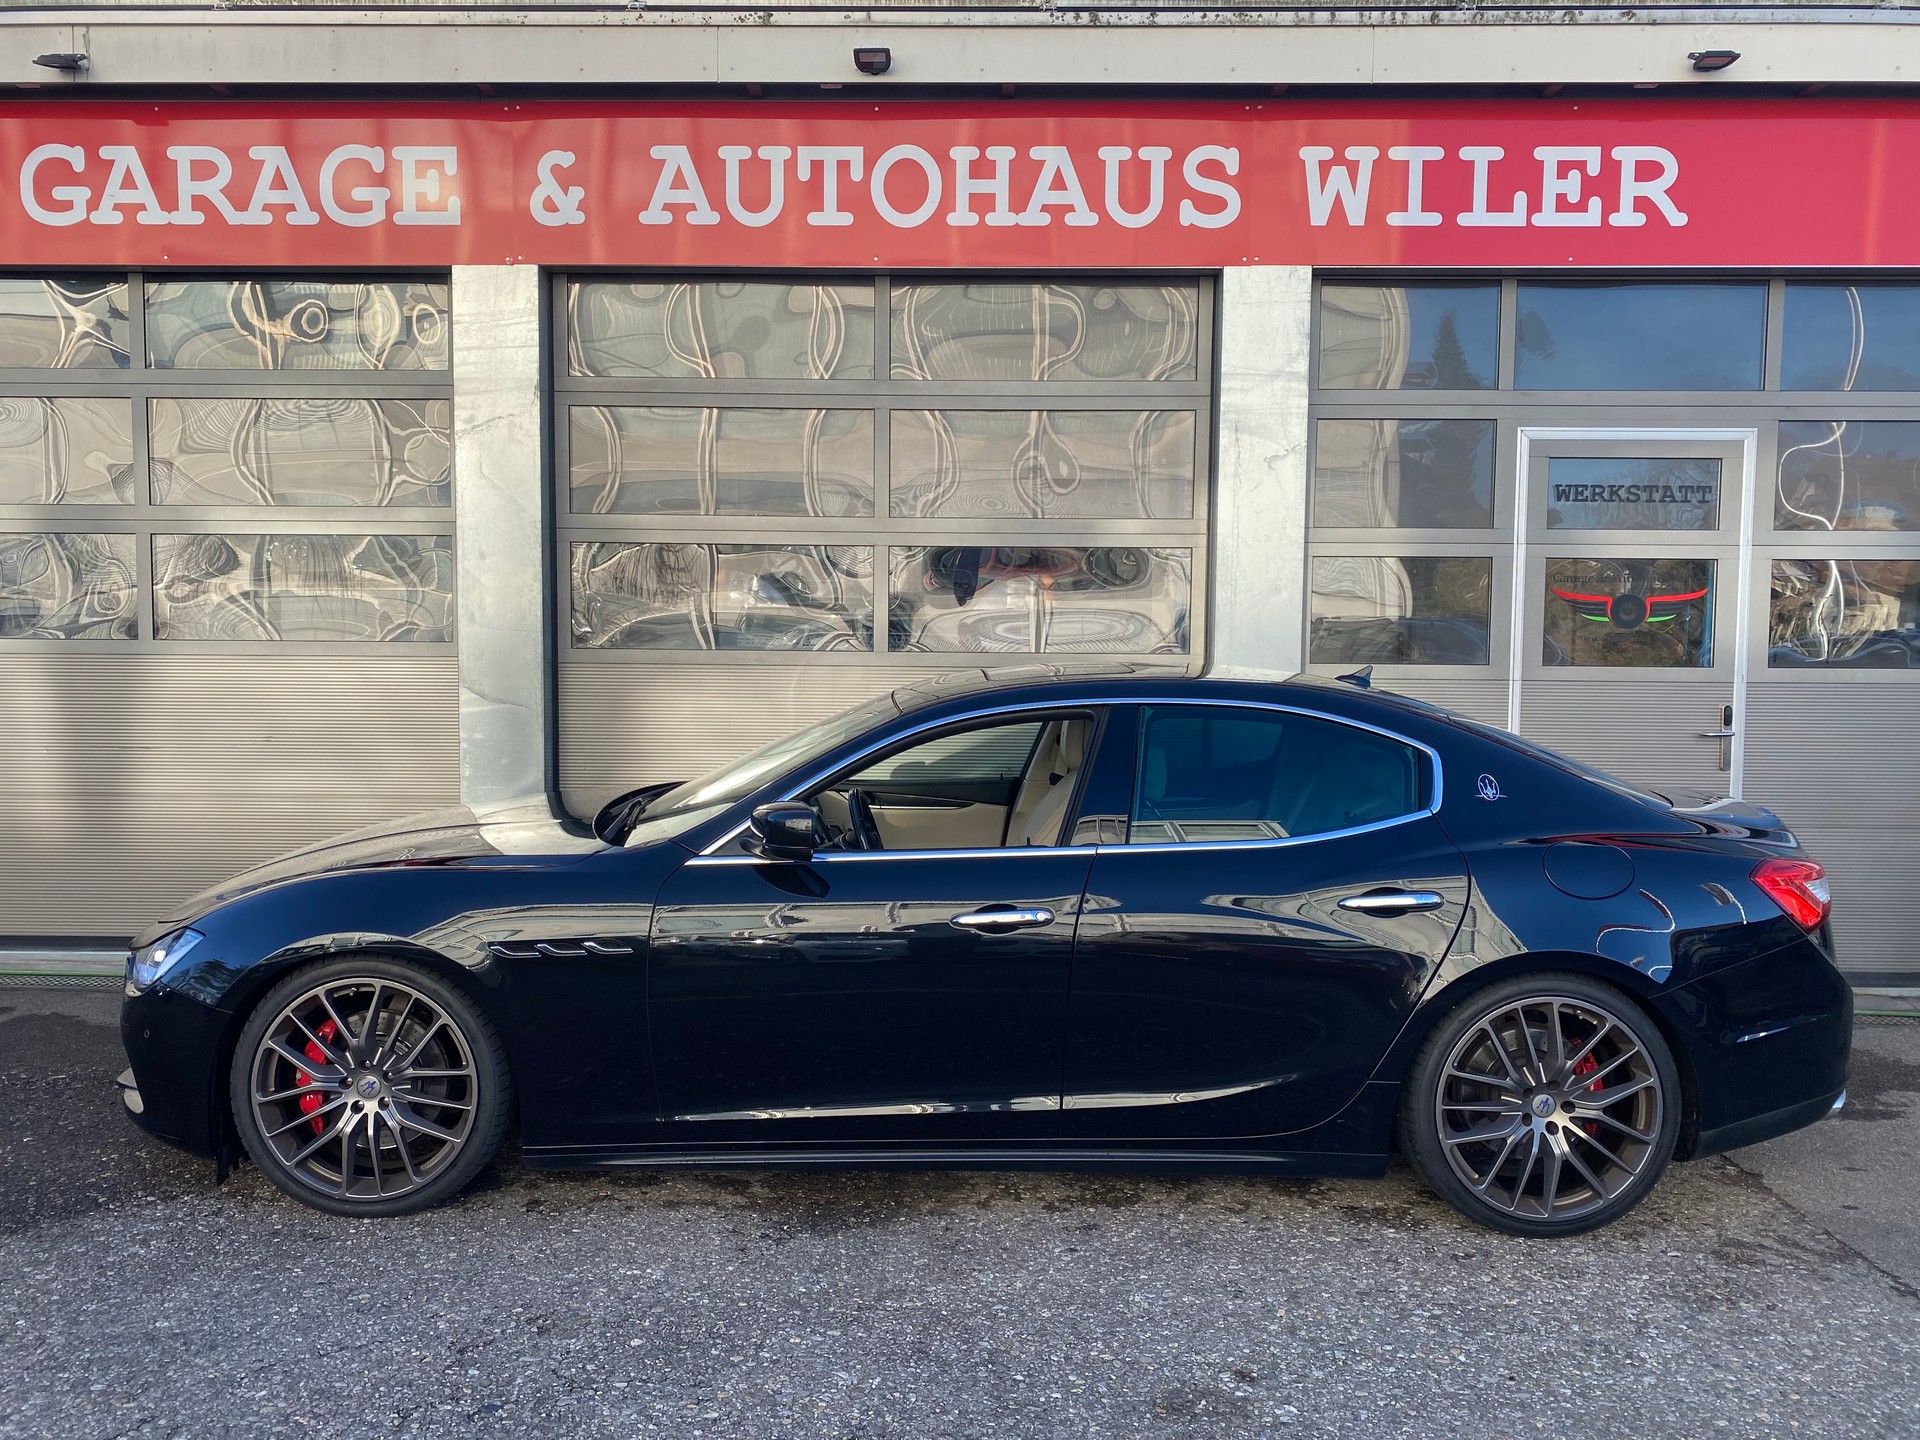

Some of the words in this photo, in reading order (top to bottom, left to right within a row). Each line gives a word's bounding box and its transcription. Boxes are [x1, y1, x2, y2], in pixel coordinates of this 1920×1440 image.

[20, 144, 460, 226] GARAGE
[530, 150, 585, 226] &
[639, 145, 1241, 228] AUTOHAUS
[1299, 146, 1688, 226] WILER
[1554, 484, 1713, 504] WERKSTATT
